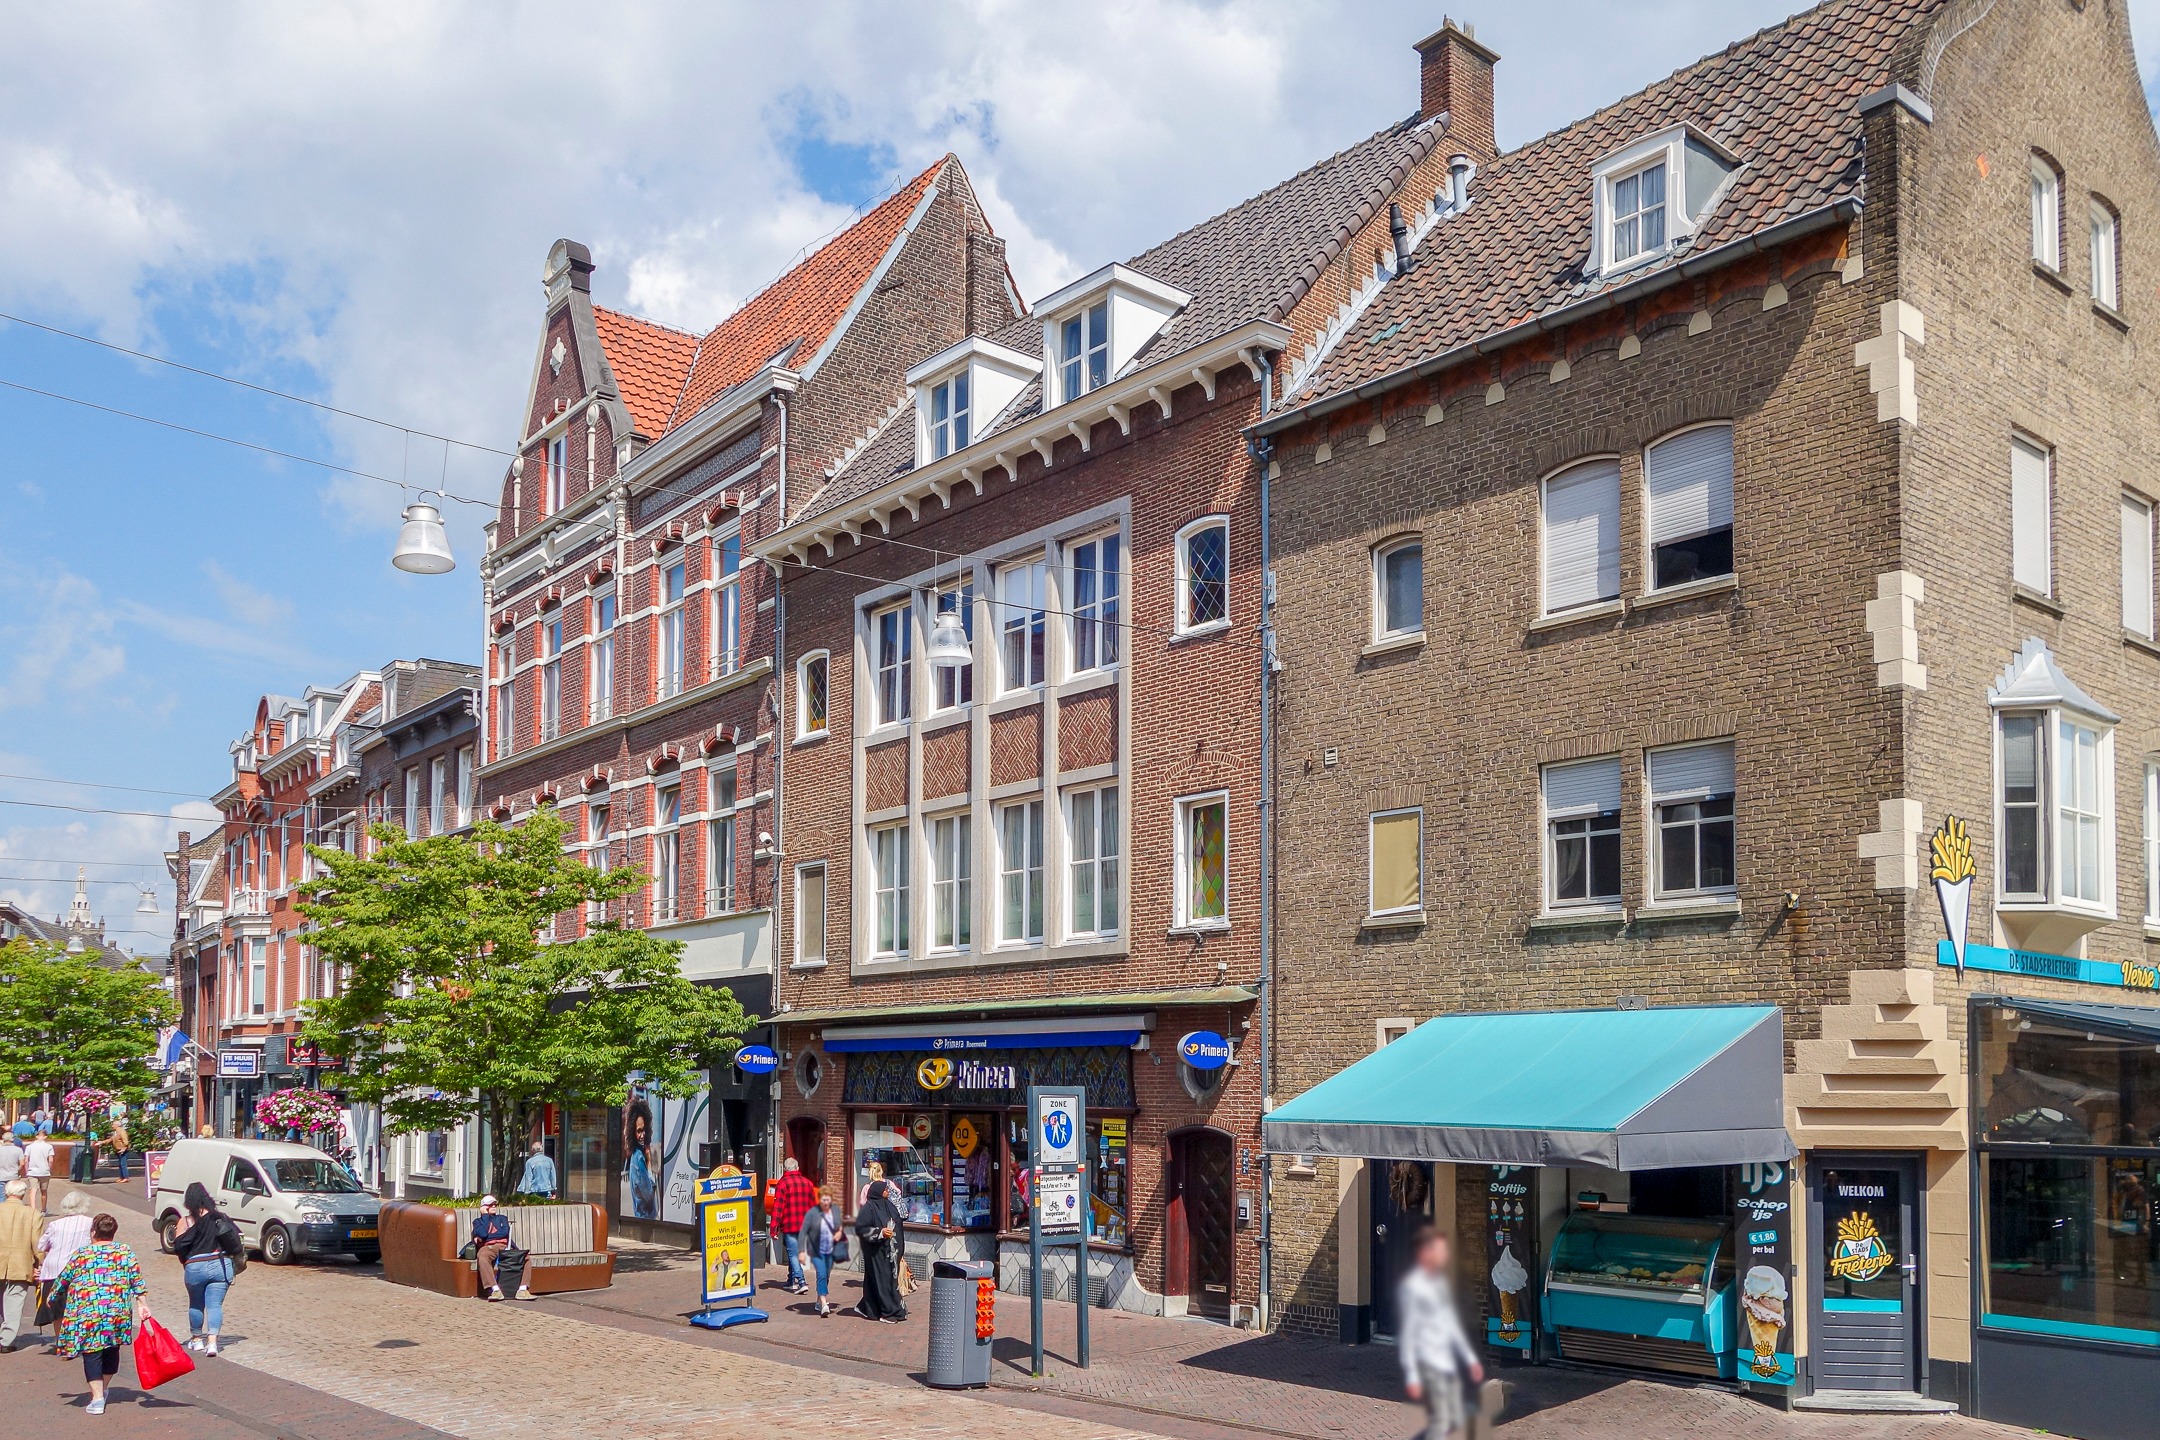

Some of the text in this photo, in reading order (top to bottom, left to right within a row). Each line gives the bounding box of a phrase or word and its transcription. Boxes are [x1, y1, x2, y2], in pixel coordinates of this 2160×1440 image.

[2009, 953, 2078, 977] DE STADSFRIETERIE
[2121, 960, 2155, 988] Verse
[944, 1038, 964, 1049] Primera
[1200, 1043, 1228, 1057] Primera
[752, 1054, 778, 1065] Primera
[958, 1060, 1015, 1089] Primera
[1050, 1100, 1067, 1108] ZONE
[1490, 1182, 1527, 1195] Softijs
[1838, 1185, 1884, 1197] WELKOM
[1737, 1198, 1788, 1211] Schep
[1752, 1209, 1773, 1221] ijs
[710, 1233, 736, 1242] zaterdag
[723, 1238, 748, 1247] Jackpot?
[1751, 1232, 1775, 1242] € 1.80
[1752, 1246, 1775, 1254] per bol
[1851, 1246, 1869, 1254] STADS
[1830, 1251, 1893, 1277] Frieterie
[731, 1271, 748, 1287] 21
